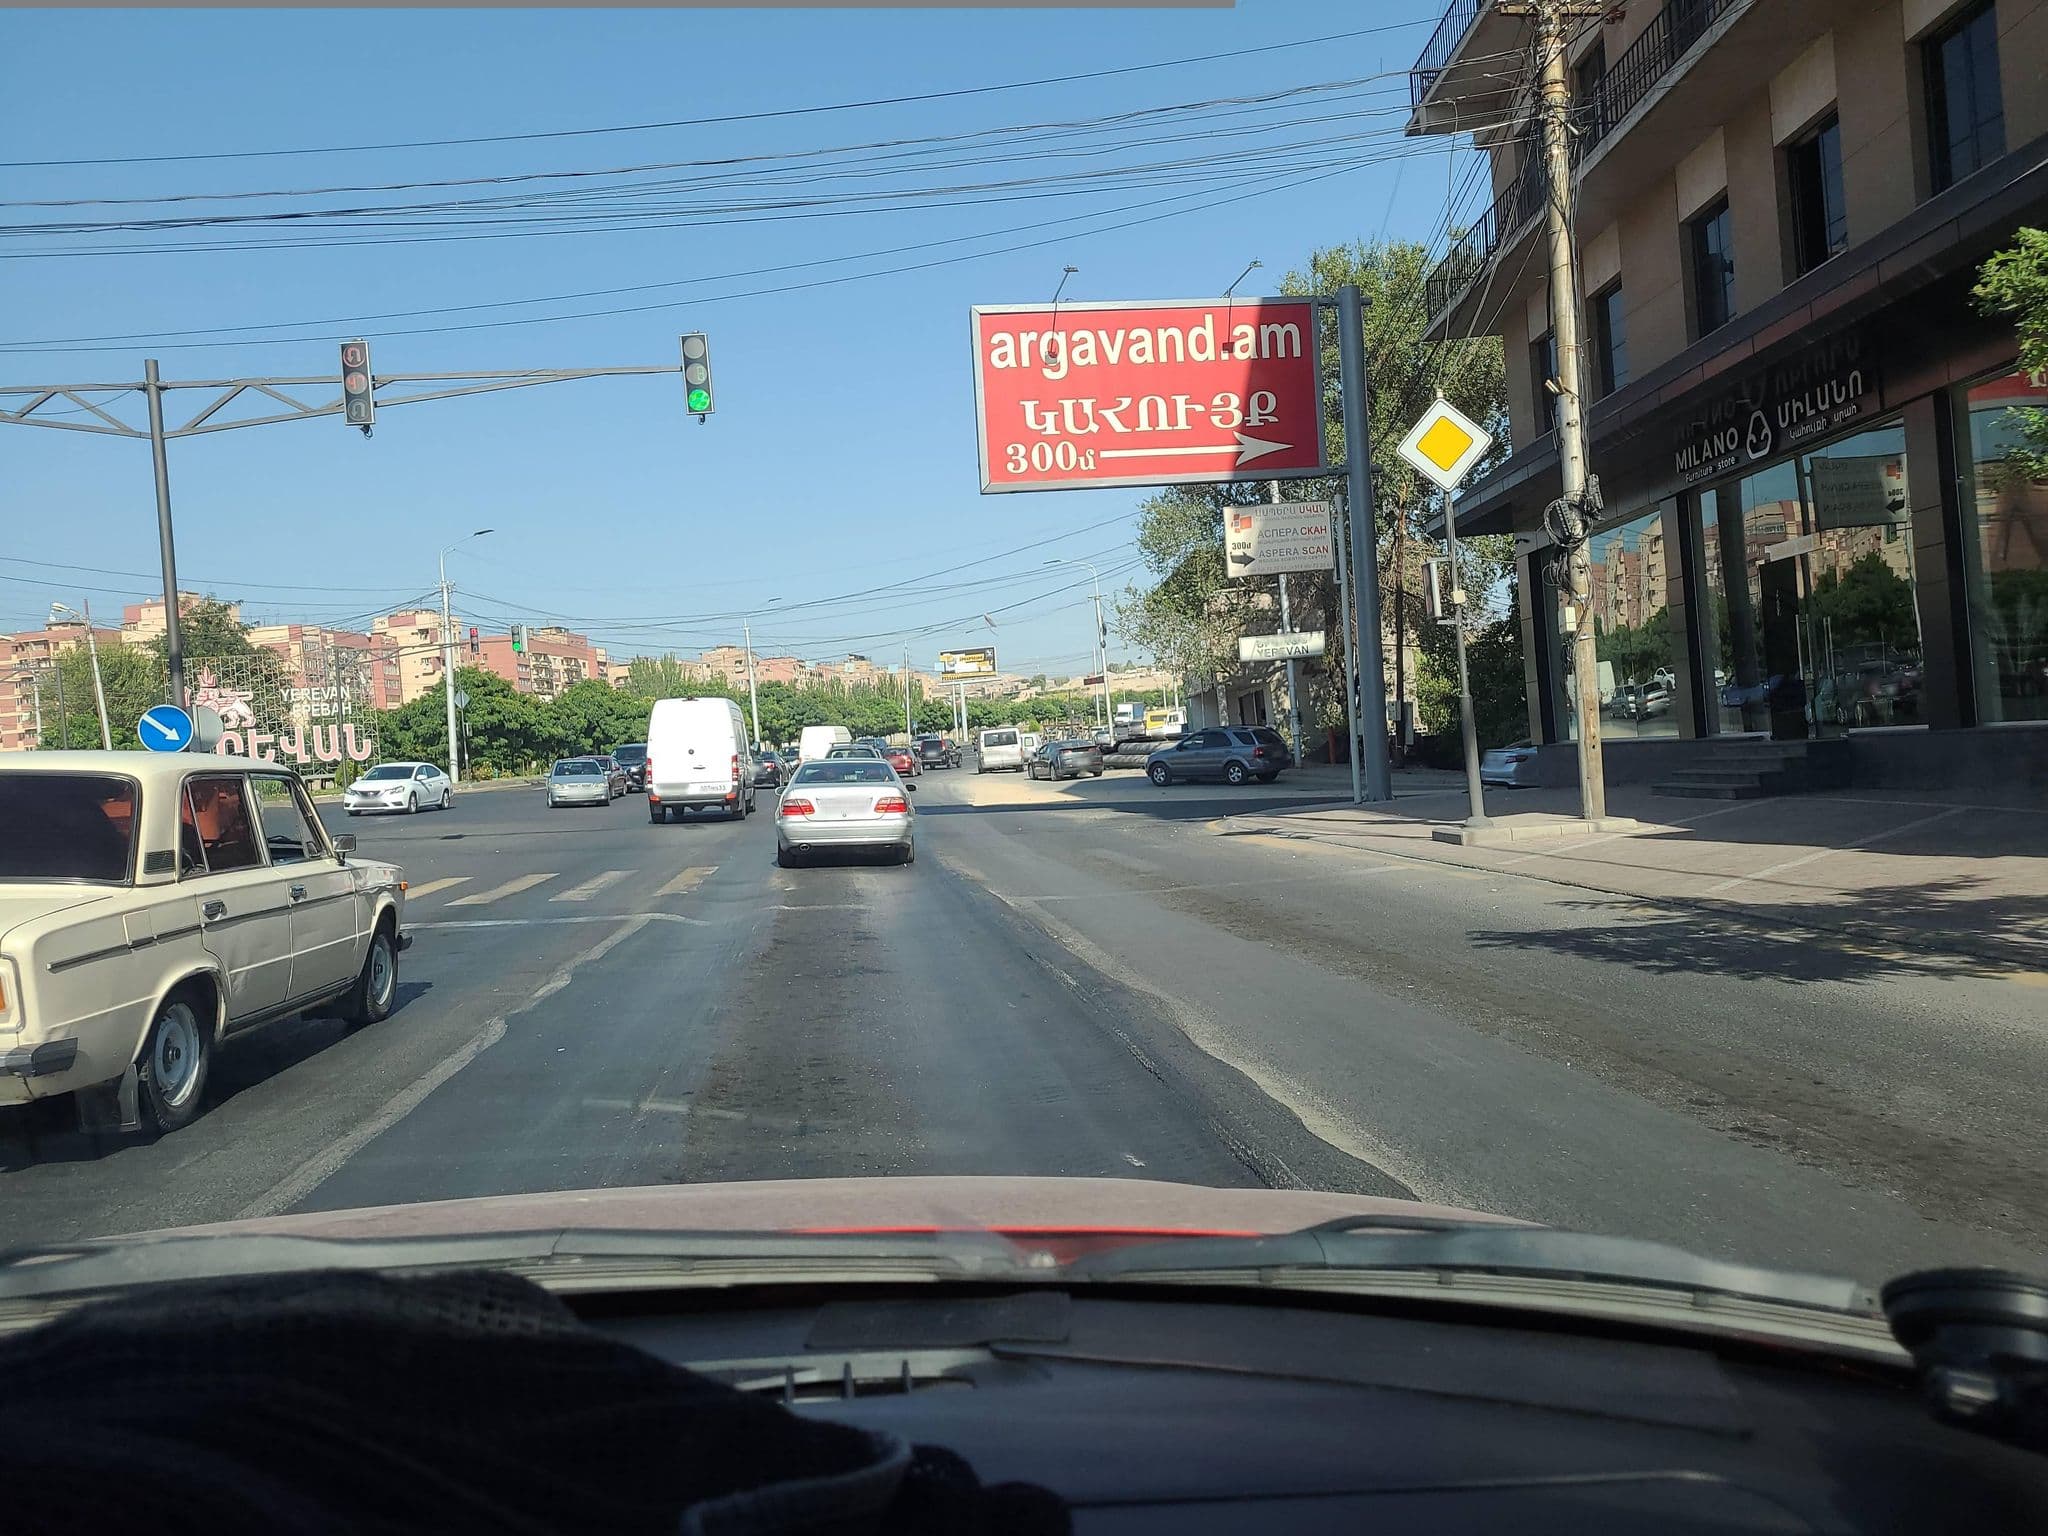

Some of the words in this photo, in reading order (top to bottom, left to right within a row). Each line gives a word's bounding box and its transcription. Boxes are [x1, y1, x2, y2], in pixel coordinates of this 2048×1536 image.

[990, 313, 1301, 380] argavand.am
[1777, 369, 1862, 429] ՄԻԼԱՆՈ
[1019, 390, 1280, 437] ԿԱՀՈՒՅՔ
[1005, 440, 1097, 474] 300մ
[1674, 427, 1738, 473] MILANO
[1717, 456, 1736, 470] store
[1258, 528, 1298, 539] АСПЕРА
[1300, 525, 1328, 536] СКАН
[1259, 547, 1300, 558] ASPERA
[1302, 545, 1329, 555] SCAN
[279, 684, 350, 703] YEREVAN
[292, 701, 353, 718] ЕРЕВАН
